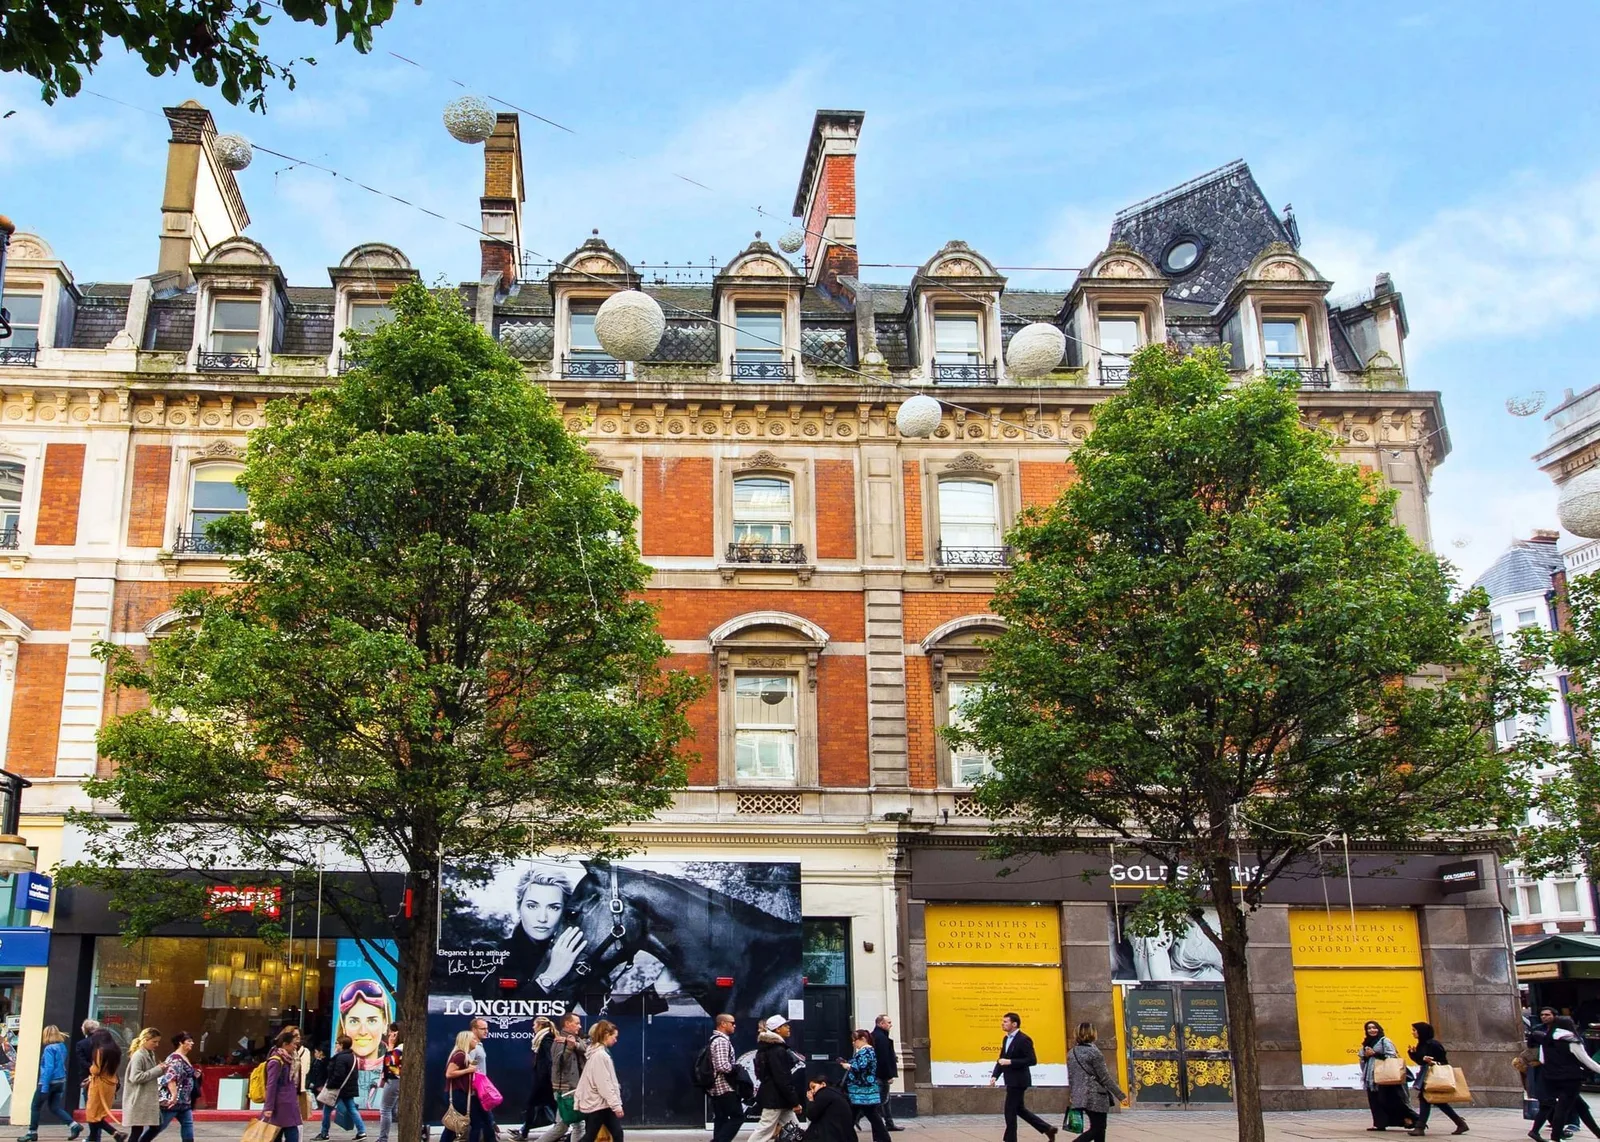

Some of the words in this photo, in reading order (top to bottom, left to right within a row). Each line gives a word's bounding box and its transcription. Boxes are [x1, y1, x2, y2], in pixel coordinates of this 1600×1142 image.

[939, 920, 1028, 928] GOLDSMITHS
[1035, 920, 1047, 928] IS
[1298, 924, 1386, 932] GOLDSMITHS
[1392, 924, 1404, 932] IS
[950, 931, 1011, 939] OPENING
[1018, 931, 1037, 939] ON
[1309, 935, 1370, 943] OPENING
[1377, 935, 1395, 943] ON
[938, 941, 992, 949] OXFORD
[1298, 945, 1352, 953] OXFORD
[438, 949, 468, 958] Elegance
[469, 949, 475, 957] is
[486, 949, 511, 957] attitude
[443, 999, 566, 1016] LONGINES
